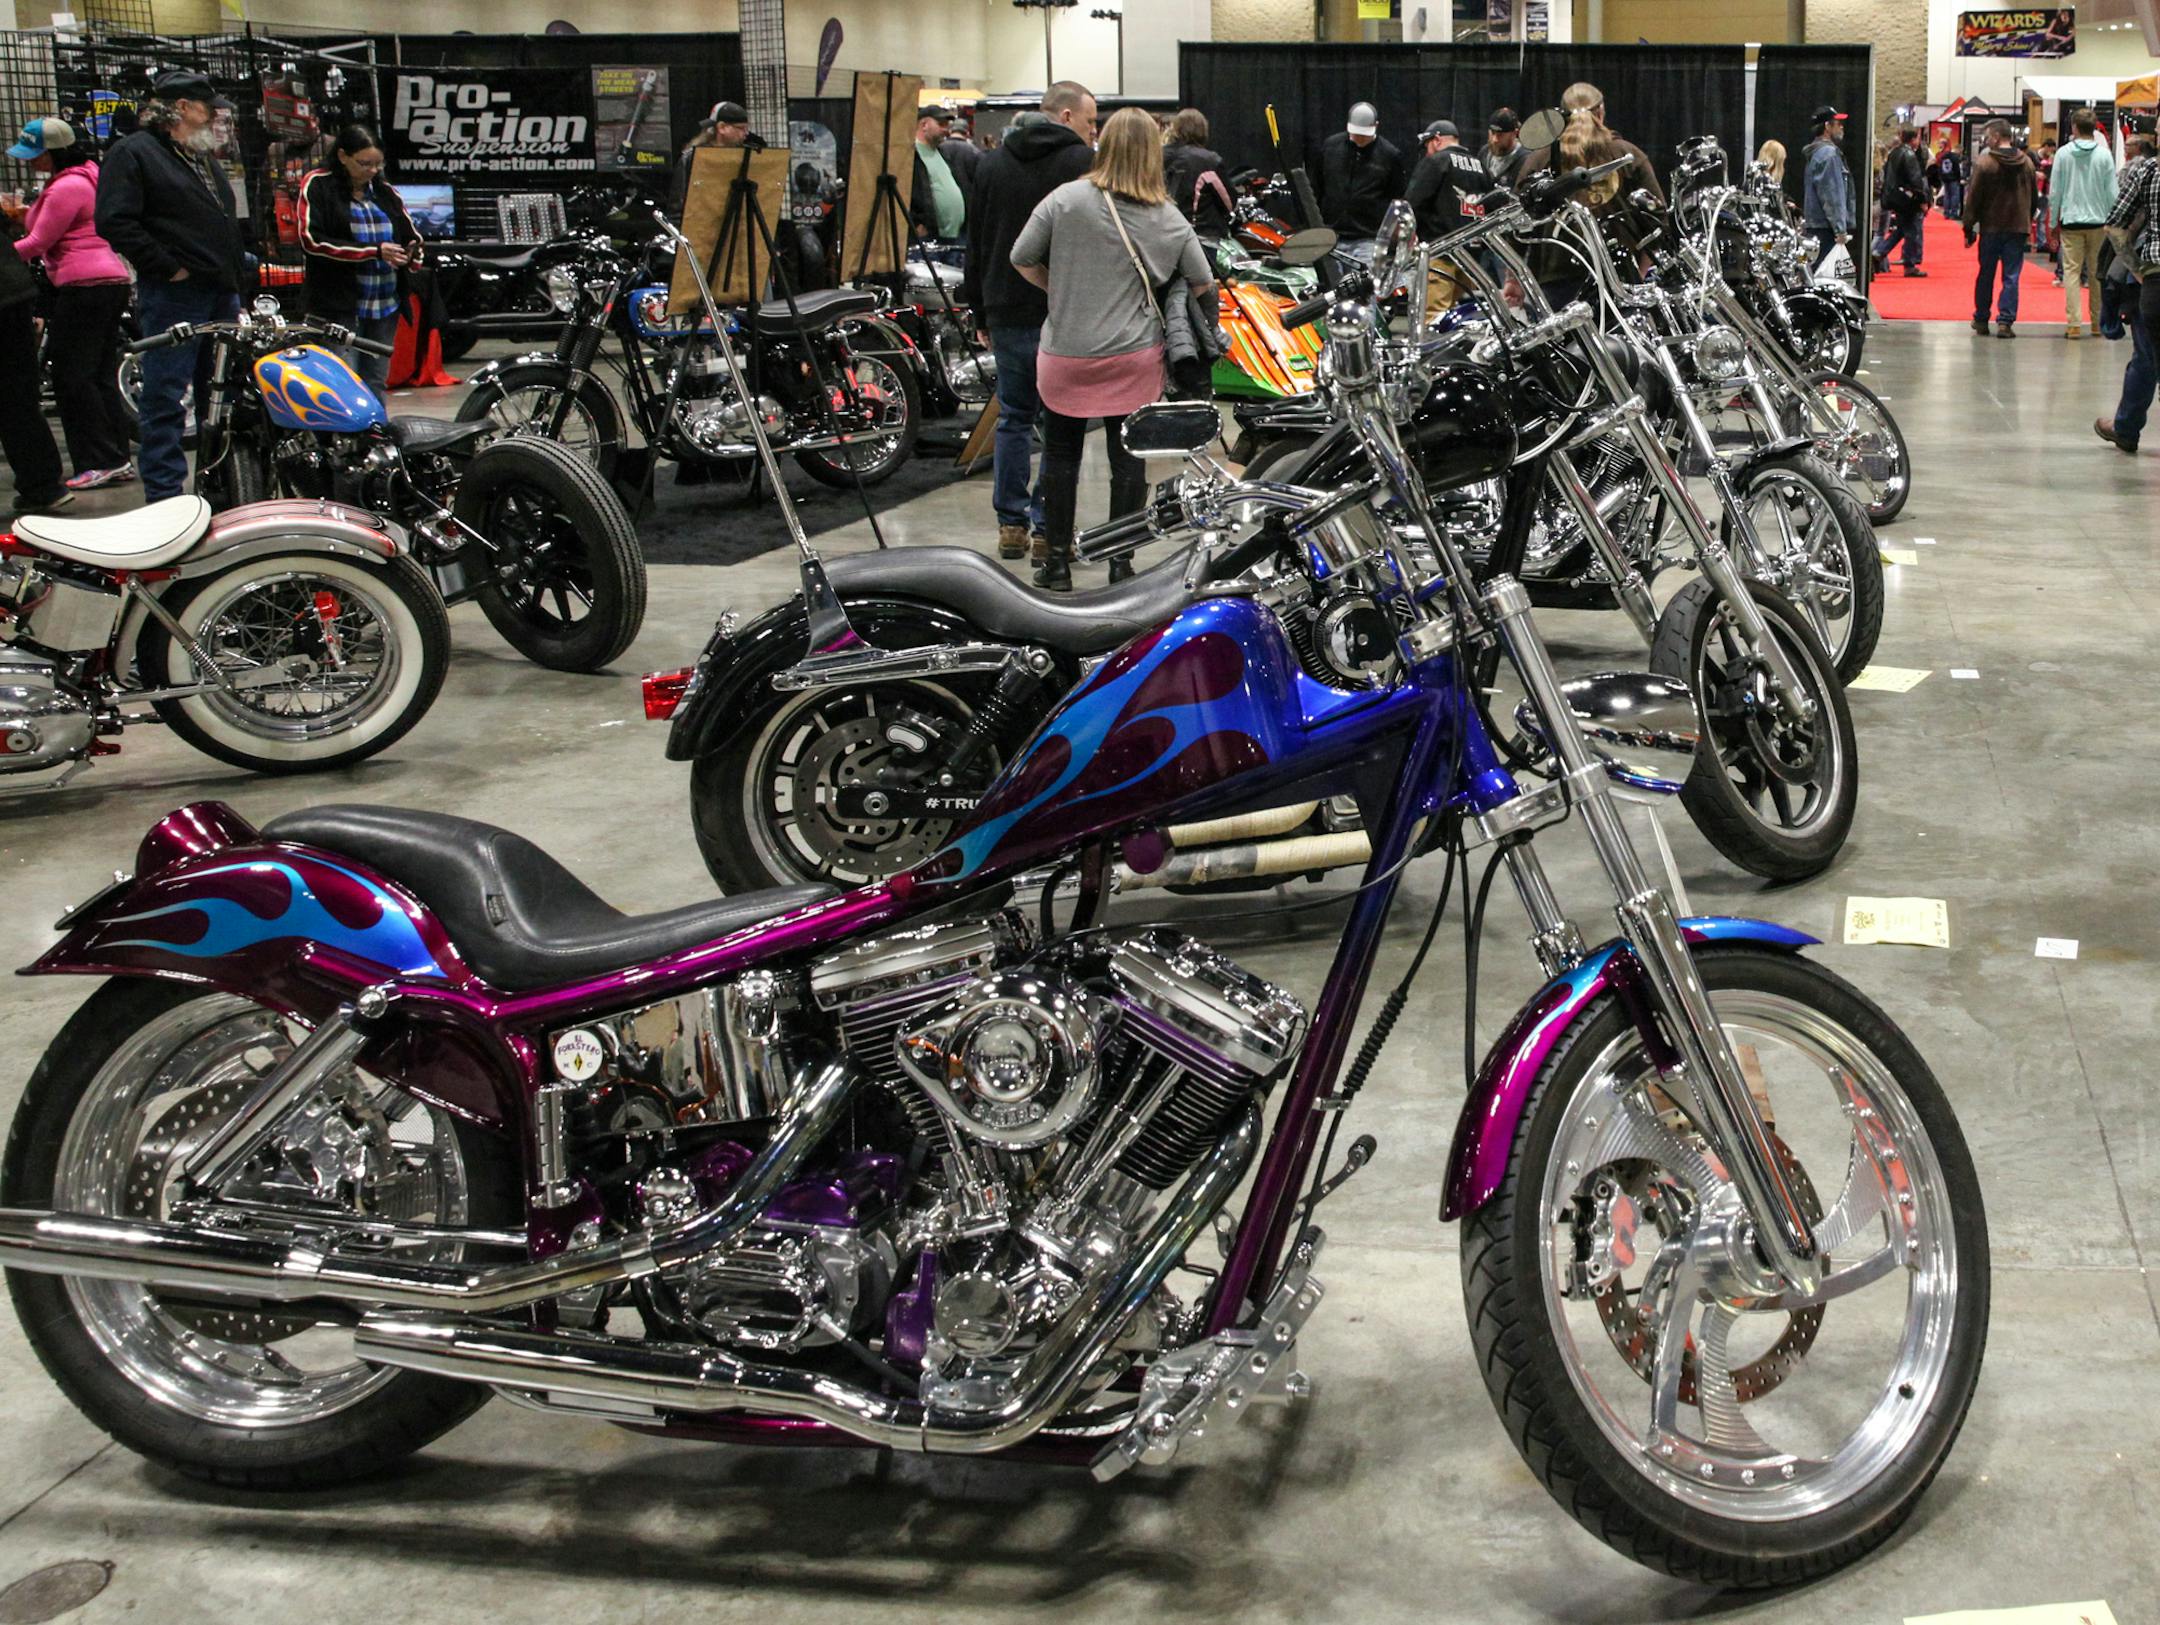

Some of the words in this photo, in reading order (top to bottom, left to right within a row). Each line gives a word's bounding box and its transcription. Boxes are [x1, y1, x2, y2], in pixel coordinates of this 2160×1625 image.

[1969, 13, 2046, 28] WIZARDS
[598, 86, 635, 94] STREETS
[393, 75, 511, 130] Pro-
[418, 132, 571, 159] Suspension
[399, 157, 596, 171] www.pro-action.com
